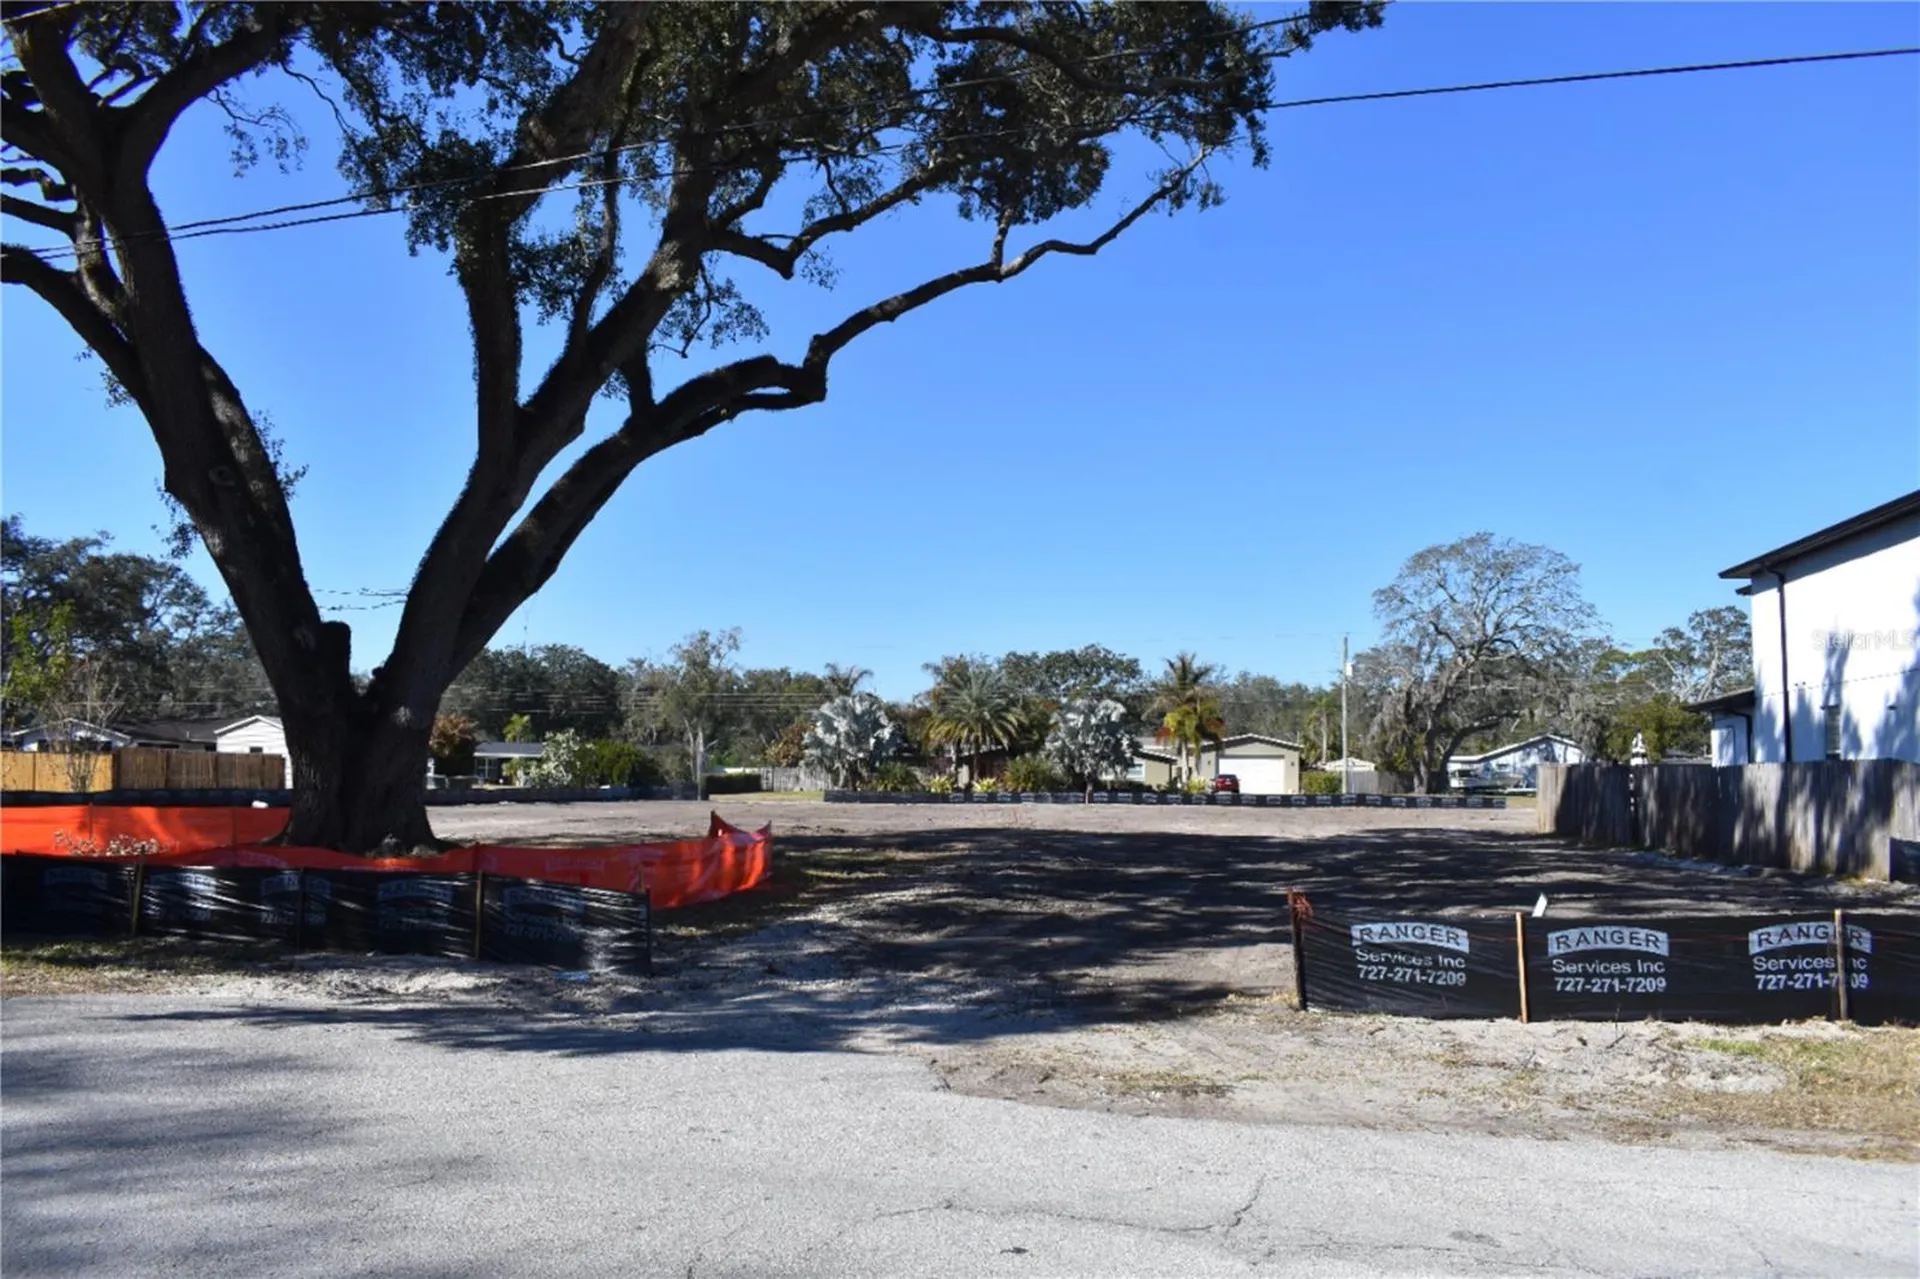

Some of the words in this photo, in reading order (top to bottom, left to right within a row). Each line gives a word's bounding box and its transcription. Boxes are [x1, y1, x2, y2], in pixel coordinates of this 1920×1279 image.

[1358, 924, 1462, 947] RANGER
[1555, 928, 1661, 951] RANGER
[1757, 924, 1864, 948] RANGR
[1356, 948, 1433, 967] Services
[1438, 954, 1466, 969] Inc
[1552, 958, 1632, 975] Services
[1637, 959, 1666, 974] Inc
[1753, 955, 1835, 972] Services
[1357, 965, 1467, 987] 727-271-7209
[1554, 976, 1667, 993] 727-271-7209
[1755, 972, 1869, 990] 727-271-709
